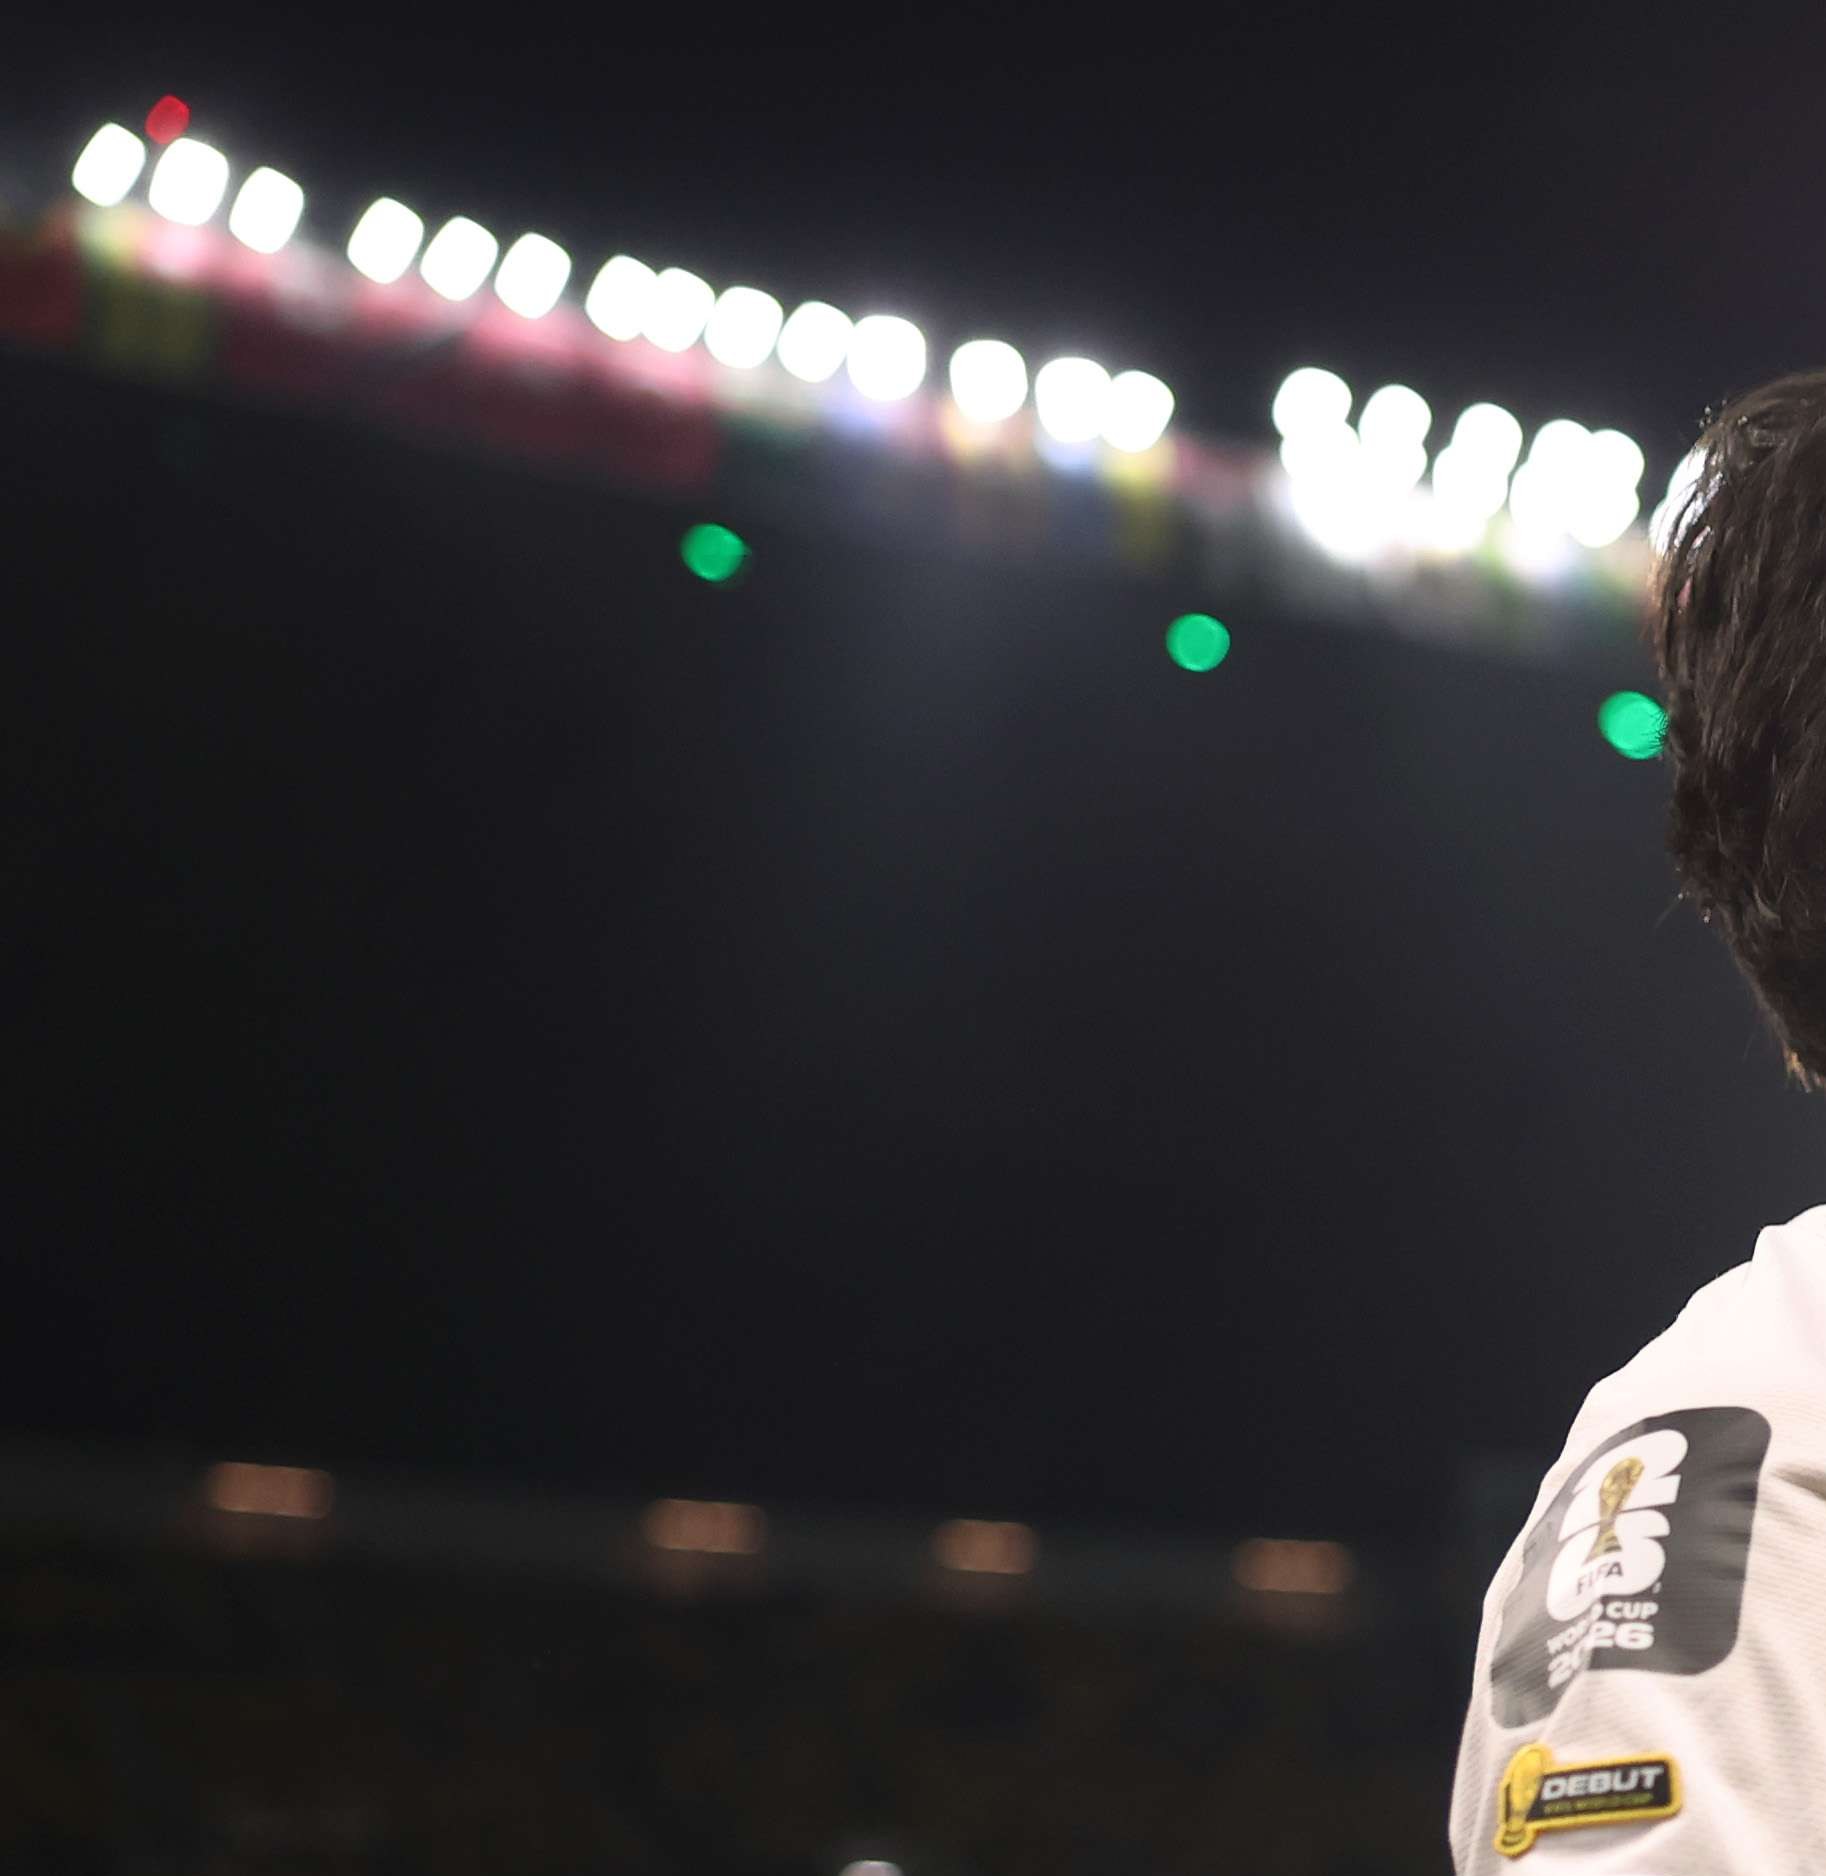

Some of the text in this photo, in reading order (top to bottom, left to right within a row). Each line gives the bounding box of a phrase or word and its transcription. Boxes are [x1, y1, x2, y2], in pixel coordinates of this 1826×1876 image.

[1576, 1561, 1624, 1596] FIFA
[1605, 1601, 1659, 1620] CUP
[1541, 1766, 1664, 1800] DEBUT
